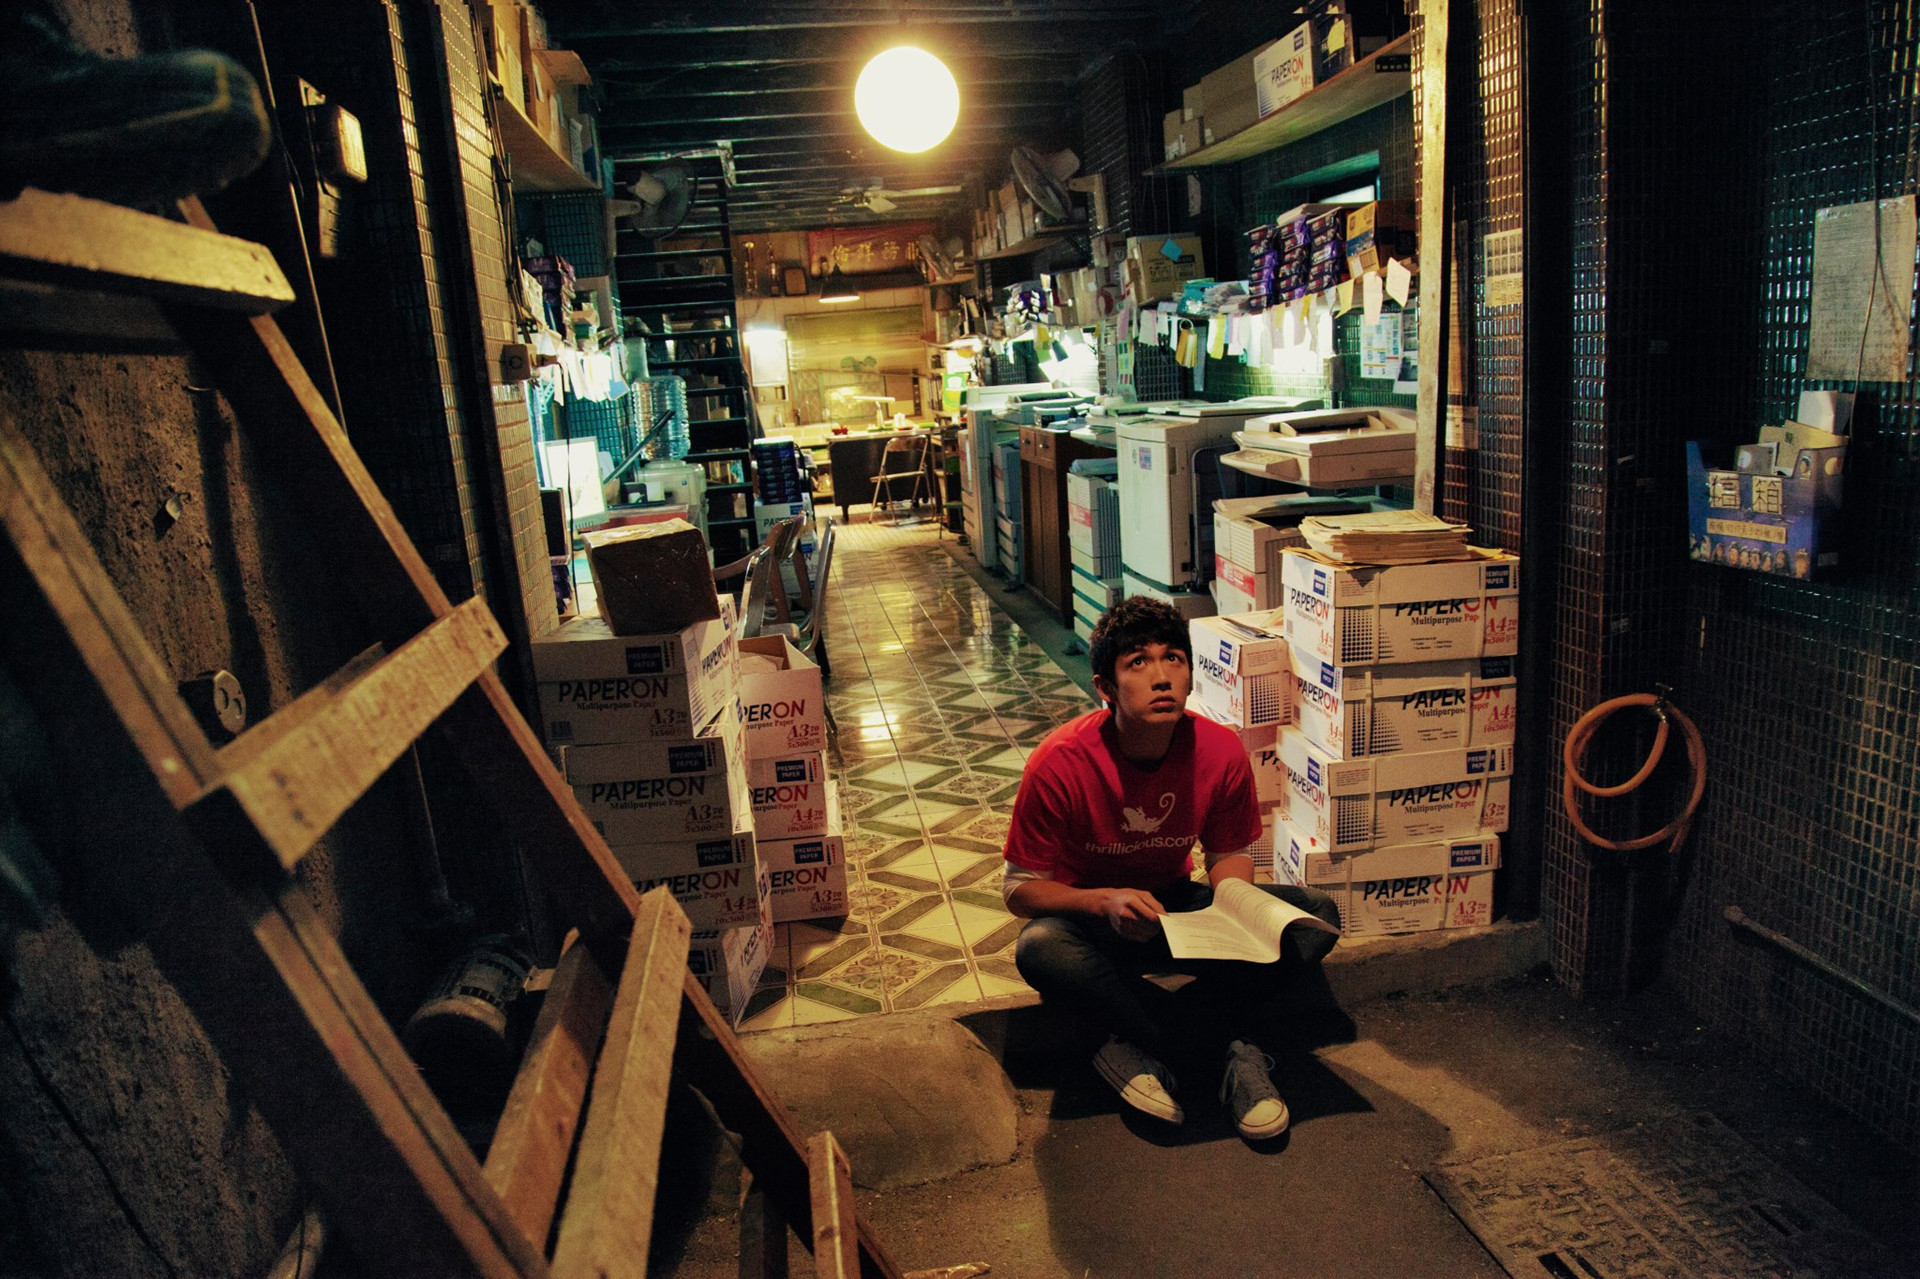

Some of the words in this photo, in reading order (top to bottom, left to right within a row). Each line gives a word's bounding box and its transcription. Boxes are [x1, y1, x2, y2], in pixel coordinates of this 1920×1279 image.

[1271, 54, 1304, 85] PAPERON
[1290, 588, 1330, 620] PAPERON
[1395, 597, 1498, 617] PAPERON
[1411, 616, 1462, 627] Multipurpose
[1464, 613, 1480, 622] Pap
[1488, 617, 1507, 632] A4
[1199, 654, 1237, 689] PAPERON
[560, 678, 669, 702] PAPERON
[1297, 678, 1339, 714] PAPERON
[577, 701, 632, 711] Multipurpose
[633, 700, 656, 709] Paper
[1402, 686, 1500, 710] PAPERON
[650, 708, 674, 724] A3
[745, 700, 805, 722] ERON
[1488, 705, 1510, 720] A4
[774, 720, 794, 728] Paper
[787, 724, 809, 738] A3
[777, 763, 804, 772] PREMIUM
[781, 771, 802, 779] PAPER
[592, 778, 705, 803] PAPERON
[752, 784, 808, 804] ERON
[1287, 767, 1325, 808] PAPERON
[611, 799, 666, 810] Multipurpose
[668, 799, 691, 808] Paper
[1405, 803, 1454, 814] Multipurpose
[1455, 800, 1475, 809] Paper
[685, 805, 711, 820] A3
[790, 808, 813, 822] A4
[795, 846, 822, 855] PREMIUM
[1085, 833, 1199, 856] thrillicious.com
[1452, 848, 1481, 856] PREMIUM
[800, 852, 819, 860] PAPER
[1456, 855, 1477, 863] PAPER
[771, 867, 827, 888] ERON
[704, 891, 727, 900] Paper
[798, 885, 816, 893] Paper
[1363, 876, 1470, 900] PAPERON
[722, 896, 746, 912] A4
[812, 890, 832, 904] A3
[1379, 898, 1430, 908] Multipurpose
[1454, 901, 1477, 916] A3
